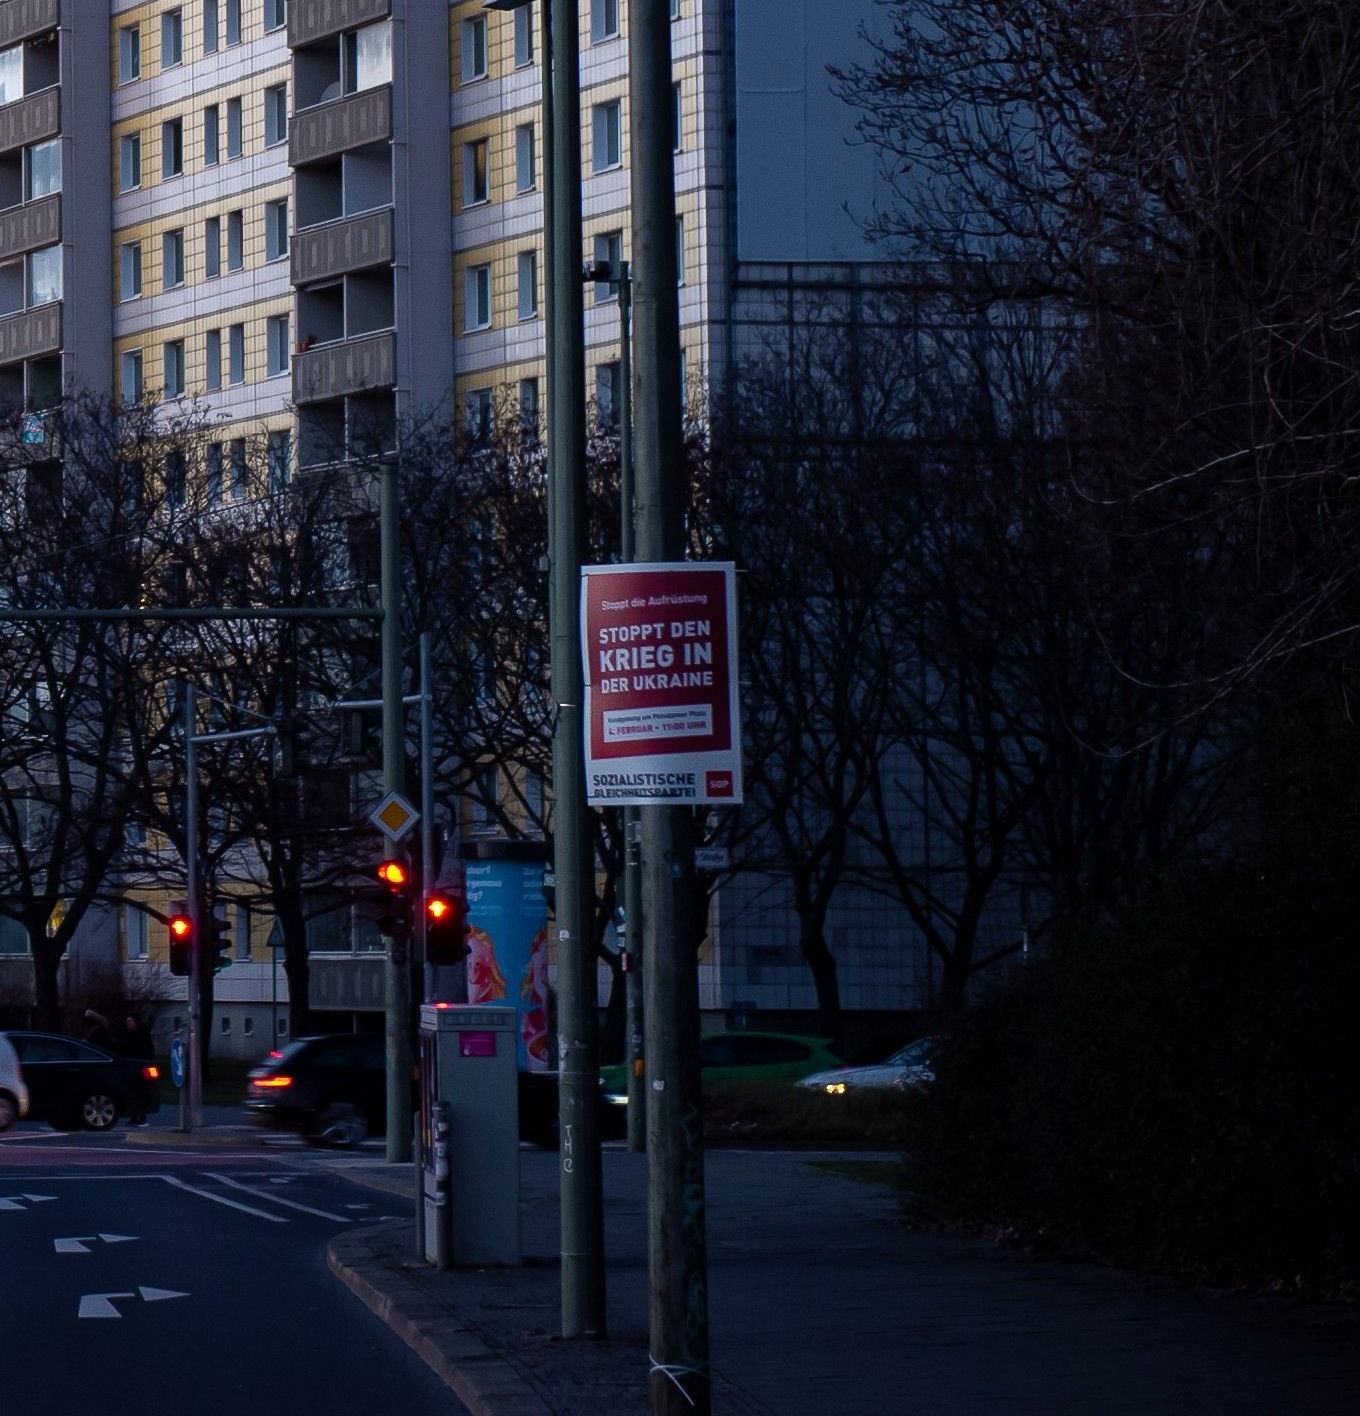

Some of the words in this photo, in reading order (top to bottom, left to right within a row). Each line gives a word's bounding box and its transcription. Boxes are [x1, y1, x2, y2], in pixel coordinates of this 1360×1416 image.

[599, 623, 664, 644] STOPPT
[670, 619, 711, 638] DEN
[599, 644, 674, 673] KRIEG
[683, 642, 713, 666] IN
[601, 677, 629, 694] DER
[633, 670, 713, 691] UKRAINE
[593, 772, 696, 787] SOZIALISTISCHE
